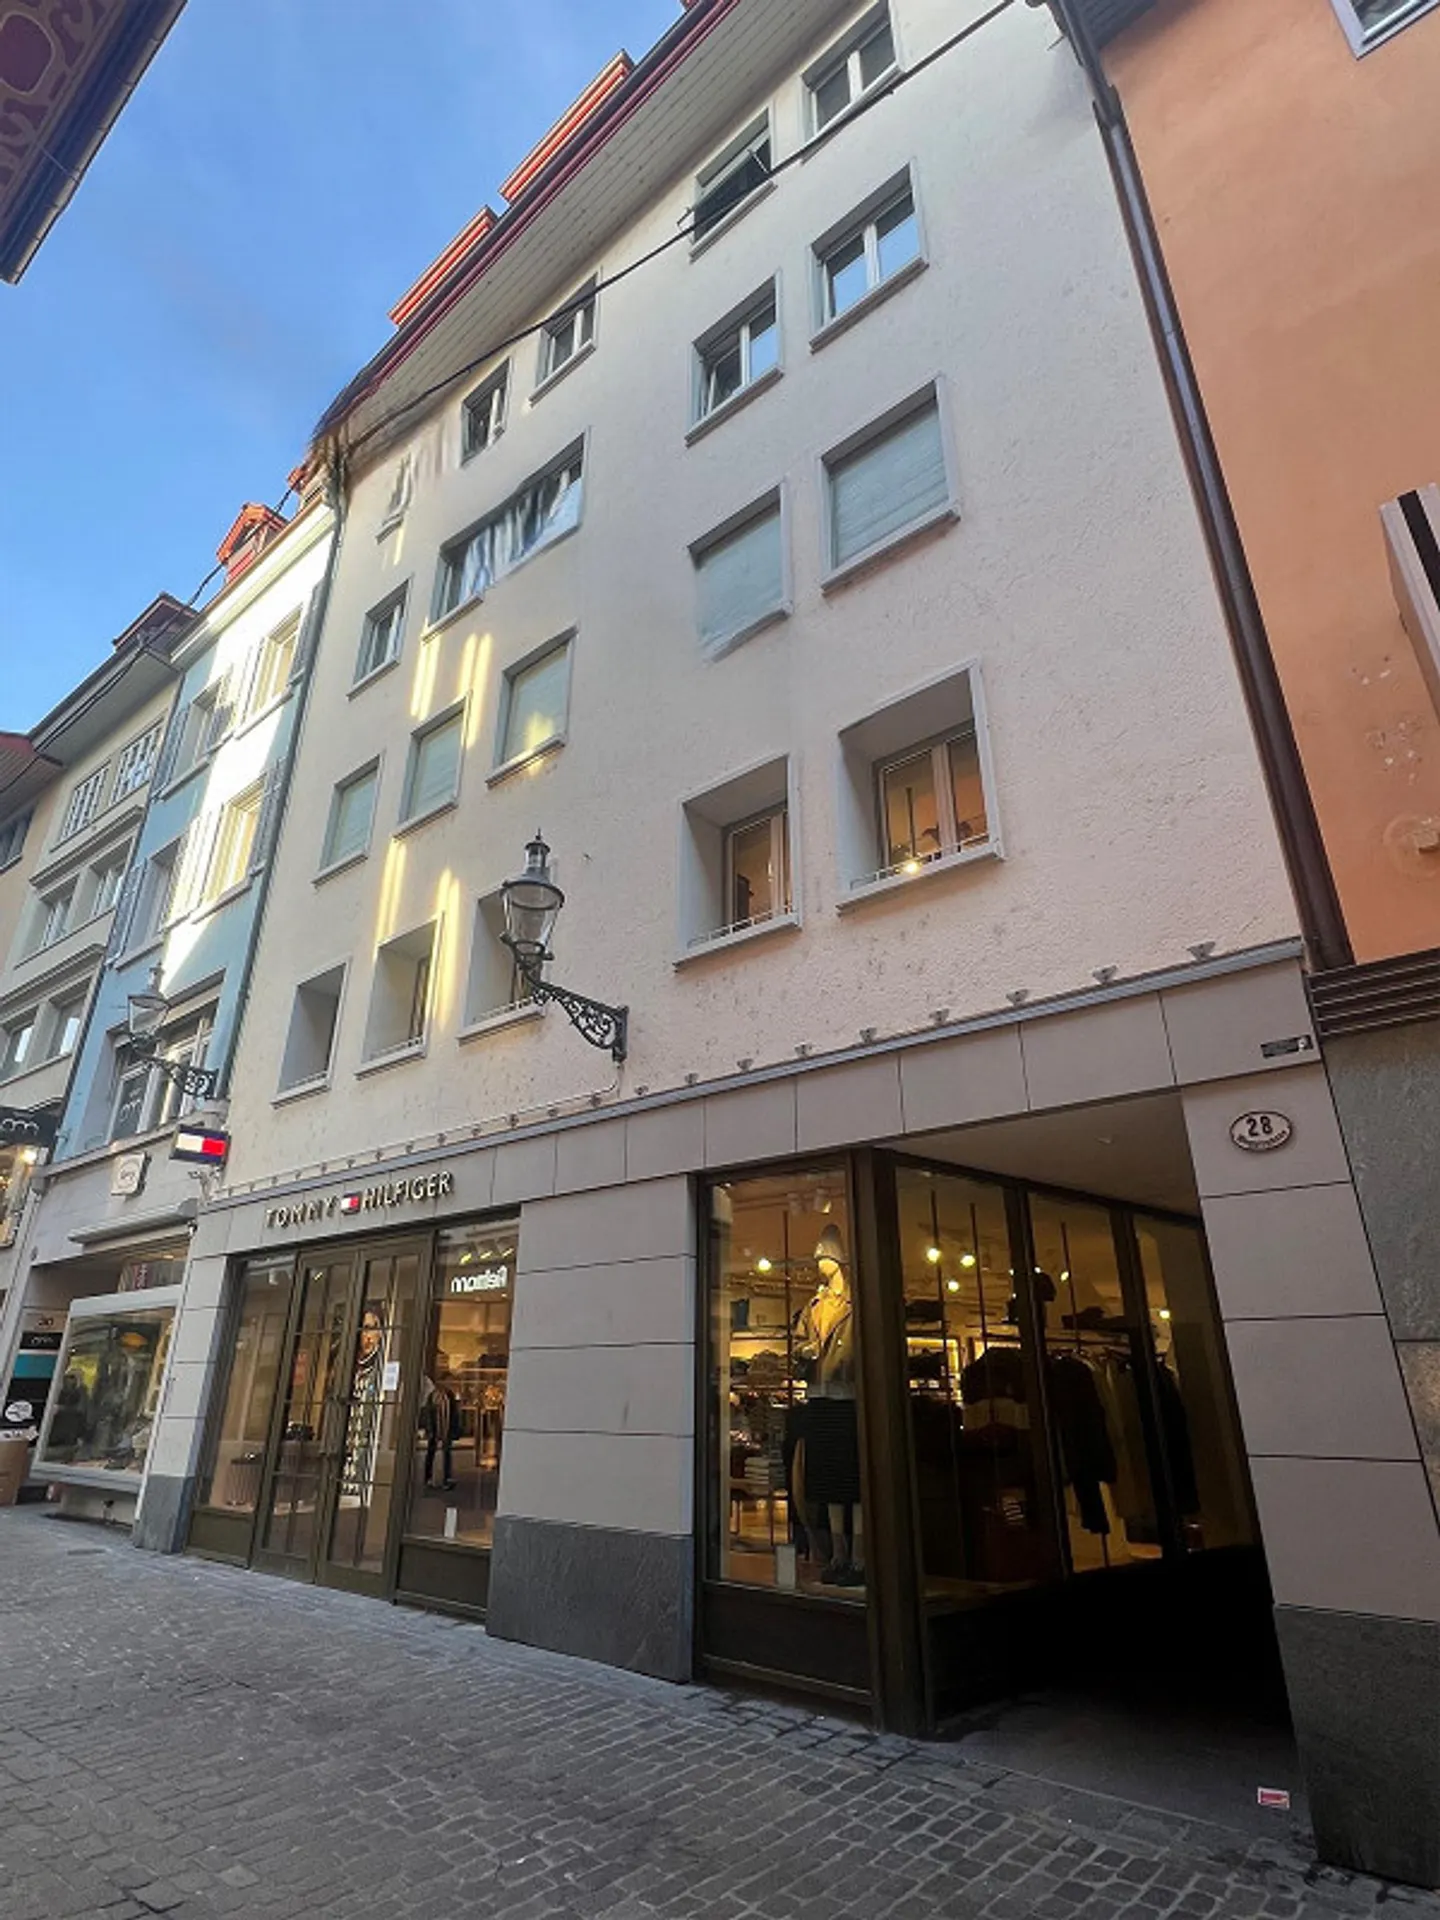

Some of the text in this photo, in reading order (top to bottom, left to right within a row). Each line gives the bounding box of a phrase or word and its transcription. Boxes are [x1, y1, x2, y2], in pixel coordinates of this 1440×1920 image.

[1246, 1116, 1273, 1136] 28
[265, 1171, 455, 1229] TOMMY HILFIGER
